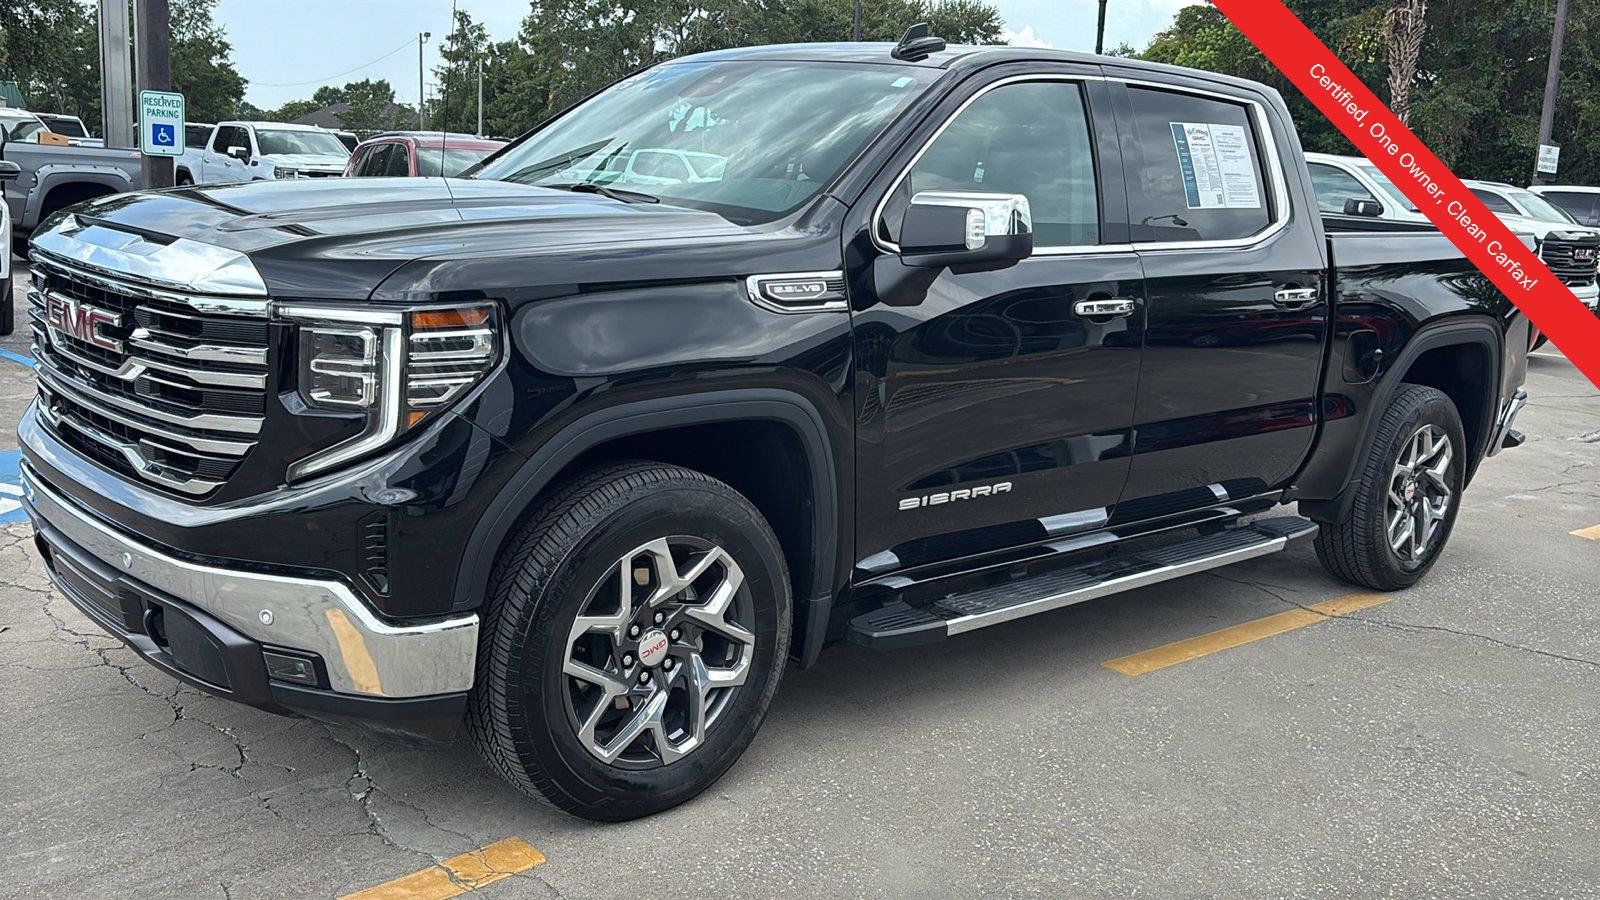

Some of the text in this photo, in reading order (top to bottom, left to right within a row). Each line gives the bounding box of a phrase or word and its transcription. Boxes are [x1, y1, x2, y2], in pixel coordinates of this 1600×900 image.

[144, 97, 181, 108] RESERVED
[146, 108, 179, 118] PARKING
[46, 291, 123, 355] GMC
[899, 481, 1012, 510] SIERRA
[641, 638, 667, 659] GMC
